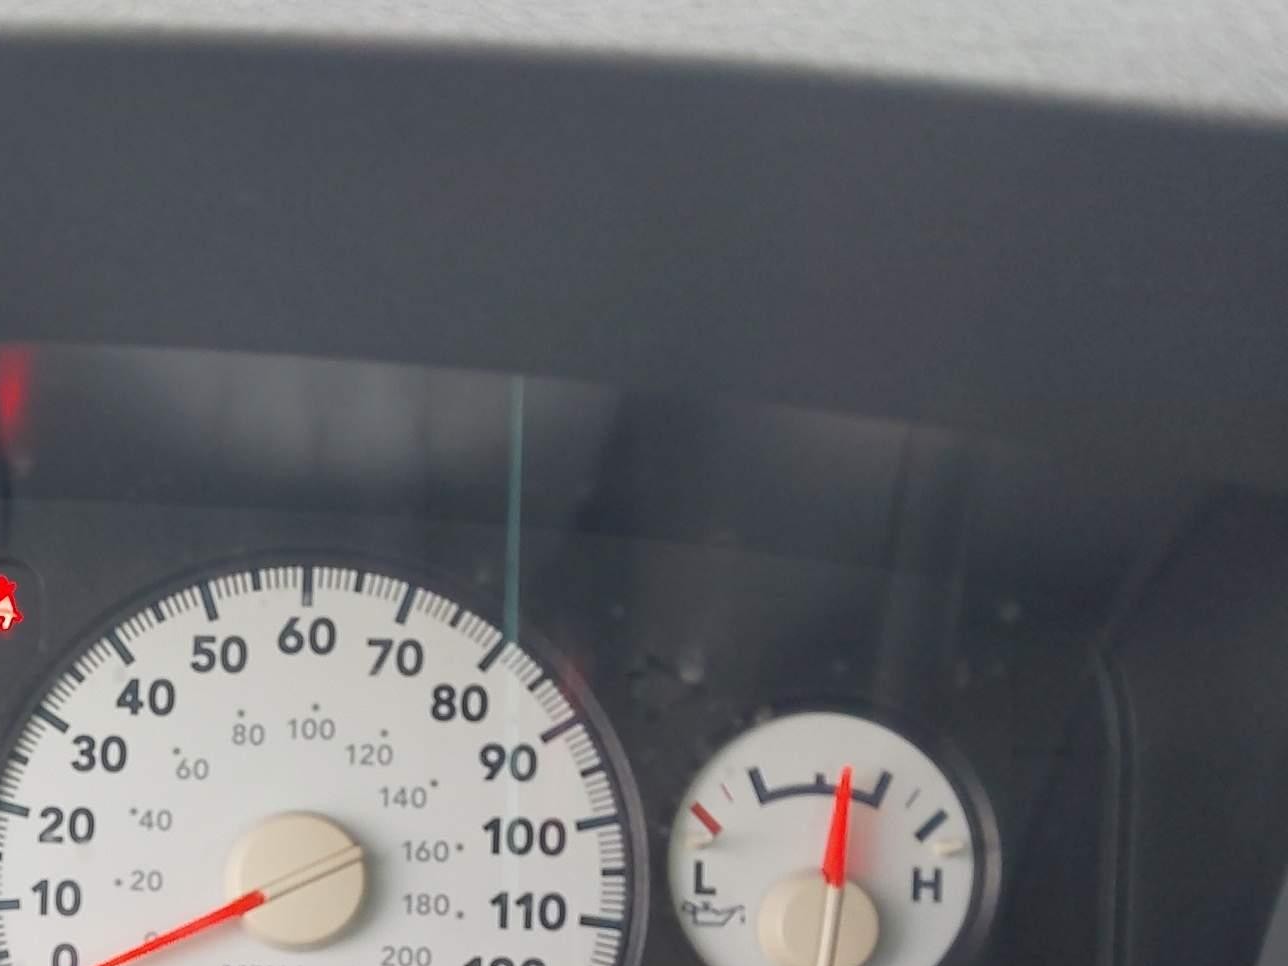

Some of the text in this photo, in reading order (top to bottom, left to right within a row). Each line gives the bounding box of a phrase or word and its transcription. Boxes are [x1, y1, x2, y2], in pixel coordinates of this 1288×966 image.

[190, 635, 248, 674] 50
[277, 616, 337, 656] 60
[367, 638, 424, 677] 70
[116, 678, 176, 717] 40
[431, 684, 489, 723] 80
[231, 723, 265, 747] 80
[288, 717, 336, 741] 100
[71, 734, 127, 773] 30
[175, 758, 210, 781] 60
[346, 743, 394, 766] 120
[479, 743, 538, 782] 90
[380, 786, 428, 809] 140
[38, 806, 95, 844] 20
[137, 808, 173, 832] 40
[483, 817, 566, 857] 100
[402, 840, 450, 863] 160
[130, 869, 163, 892] 20
[693, 860, 717, 896] L
[911, 867, 942, 903] H
[31, 879, 82, 917] 10
[402, 893, 451, 917] 180
[490, 892, 567, 931] 110
